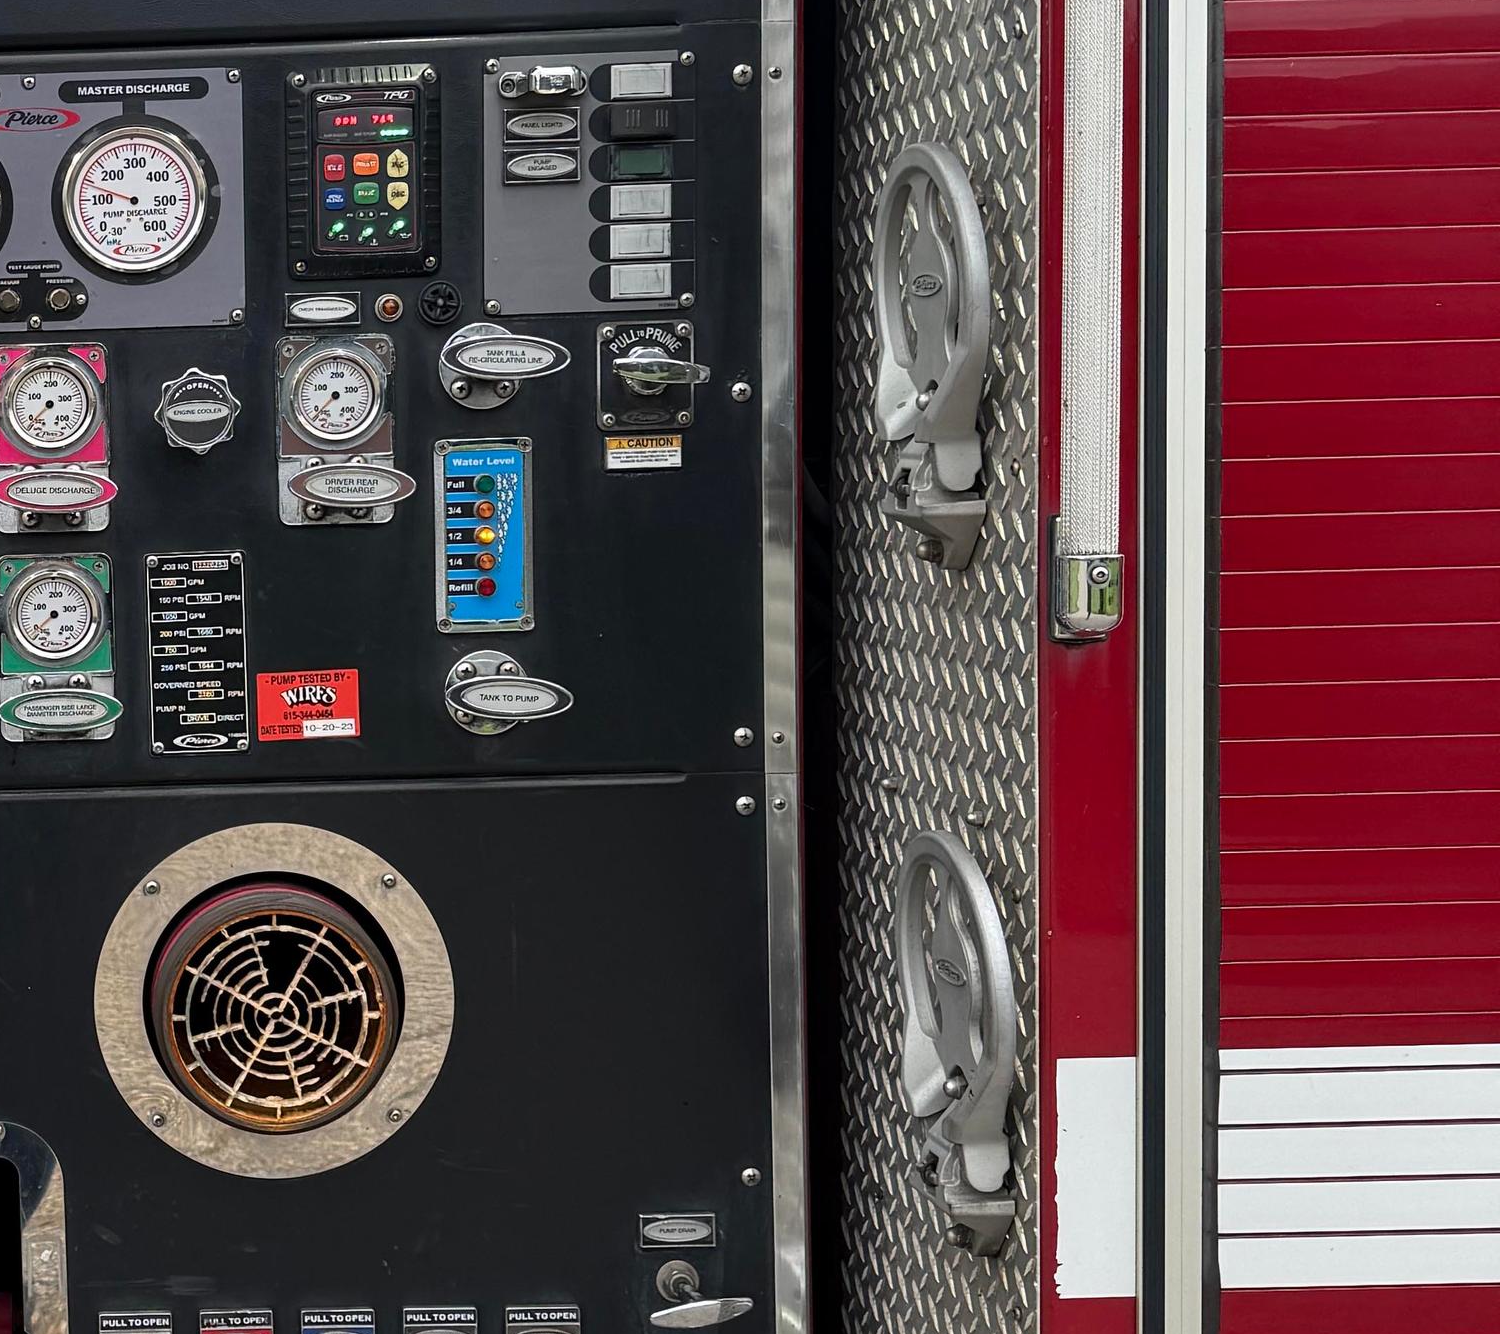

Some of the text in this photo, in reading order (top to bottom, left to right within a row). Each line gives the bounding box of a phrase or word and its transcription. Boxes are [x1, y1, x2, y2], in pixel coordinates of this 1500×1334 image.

[77, 82, 190, 95] MASTER DISCHARGE
[384, 91, 409, 99] TPG
[4, 109, 59, 128] Pierce
[123, 158, 146, 170] 300
[101, 170, 124, 181] 200
[146, 171, 169, 183] 400
[92, 194, 113, 205] 100
[153, 195, 177, 206] 500
[127, 208, 167, 216] DISCHARGE
[100, 221, 107, 231] 0
[144, 220, 166, 231] 600
[609, 329, 639, 354] PULL
[645, 327, 682, 354] PRIME
[186, 383, 209, 391] OPEN
[627, 438, 674, 447] CAUTION
[452, 456, 515, 466] Water Level
[447, 481, 464, 489] Full
[448, 507, 462, 515] 3/4
[449, 583, 473, 591] Refill
[271, 673, 345, 685] PUMP TESTED BY
[281, 685, 337, 706] WIRFS
[516, 695, 539, 703] PUMP
[261, 726, 276, 735] DATE
[305, 723, 353, 731] 10-20-23
[304, 1315, 330, 1323] PULL
[344, 1314, 372, 1322] OPEN
[447, 1313, 474, 1321] OPEN
[549, 1312, 577, 1320] OPEN
